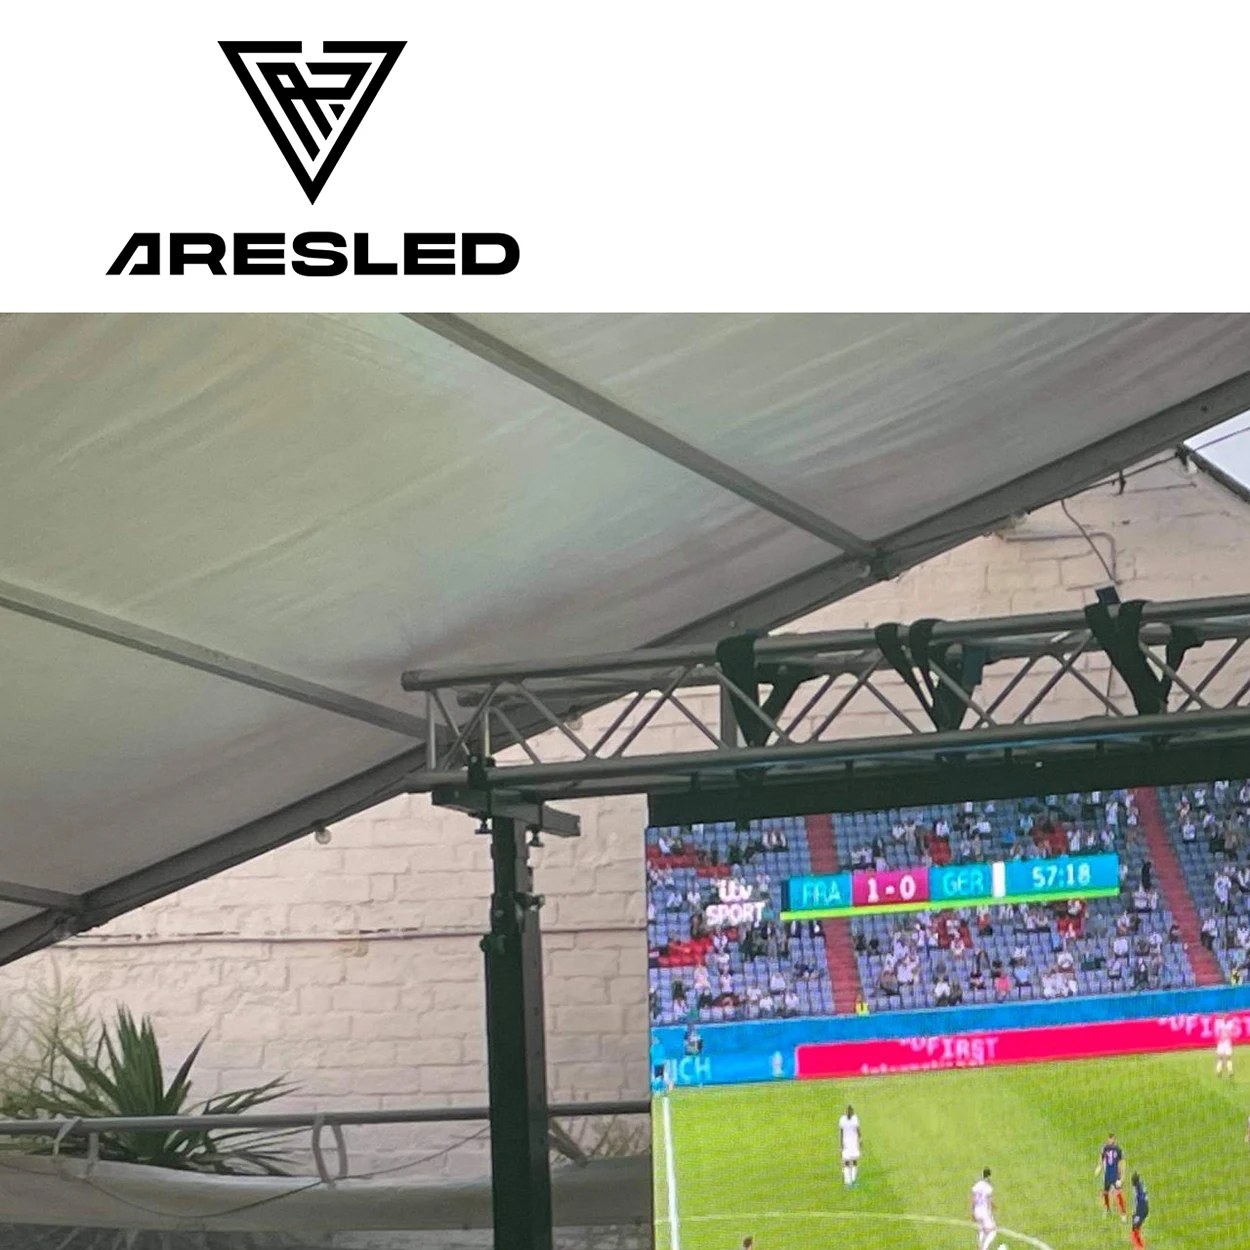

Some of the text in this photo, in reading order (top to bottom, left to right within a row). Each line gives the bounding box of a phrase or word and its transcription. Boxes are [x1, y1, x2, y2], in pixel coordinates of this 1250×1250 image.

[802, 881, 841, 904] FRA
[942, 869, 984, 896] GER
[1032, 862, 1090, 888] 57:18
[705, 902, 765, 927] SPORT
